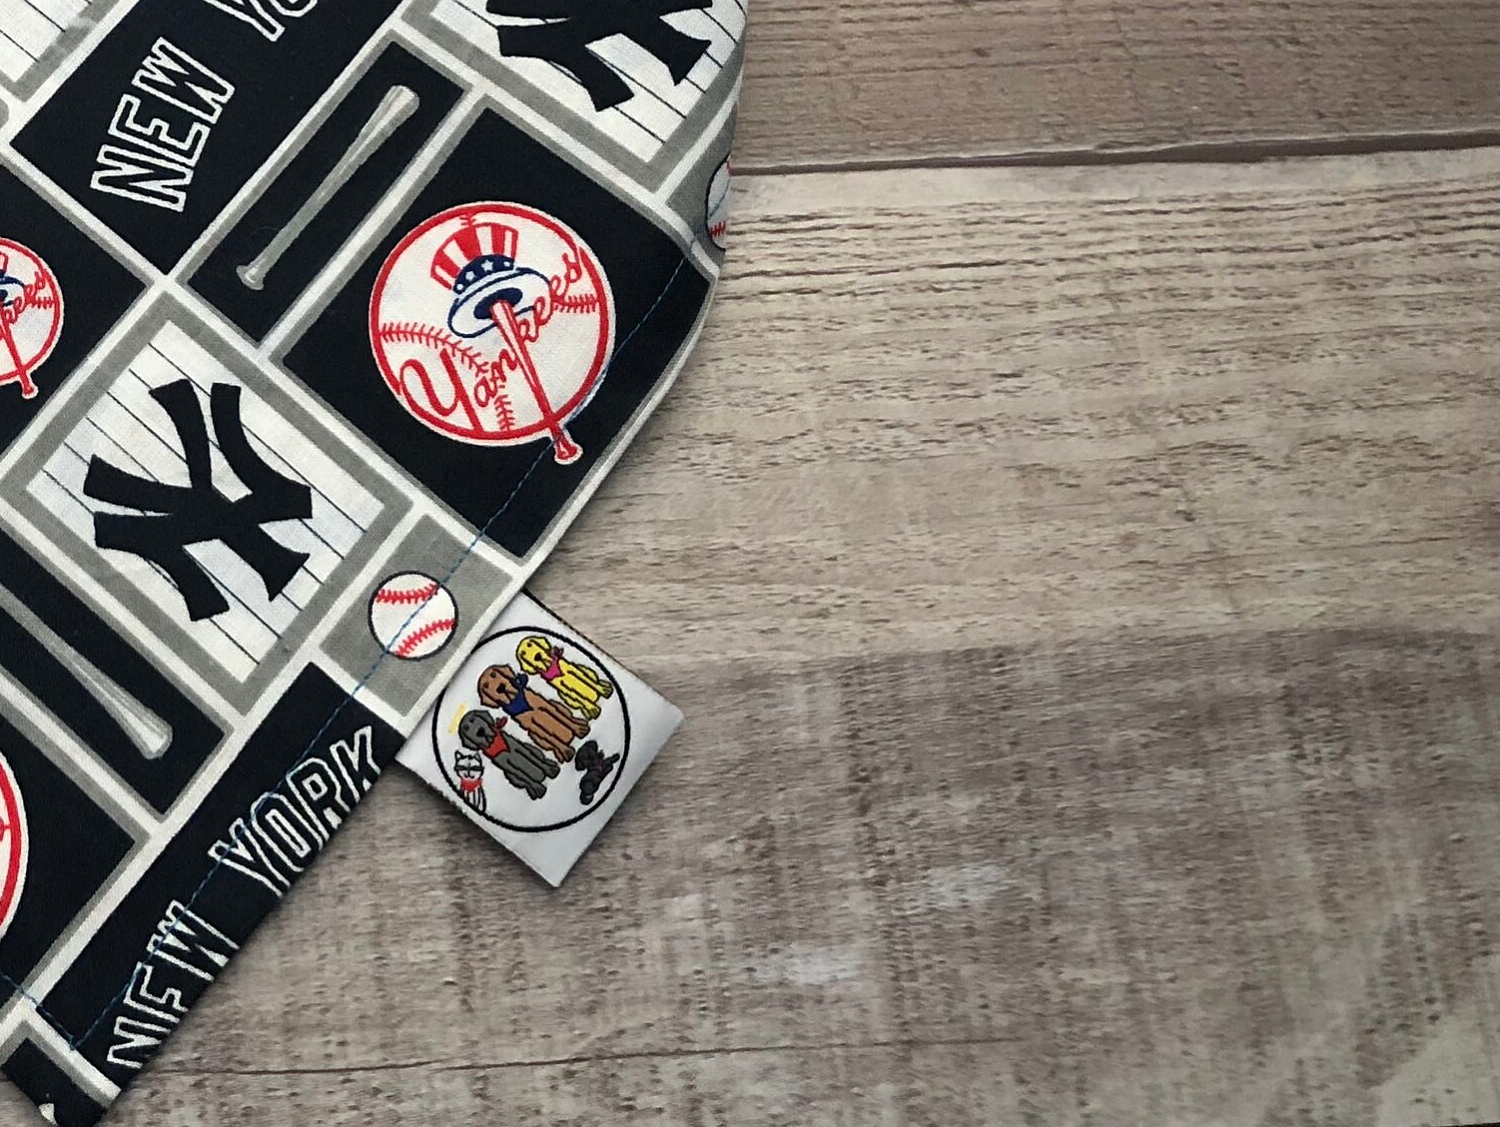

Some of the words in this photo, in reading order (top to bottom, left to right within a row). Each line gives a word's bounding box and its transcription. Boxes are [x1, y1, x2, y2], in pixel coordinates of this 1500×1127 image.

[90, 36, 236, 213] NEW
[397, 251, 586, 434] Yankees
[107, 899, 240, 1070] NEW
[207, 725, 381, 898] YORK
